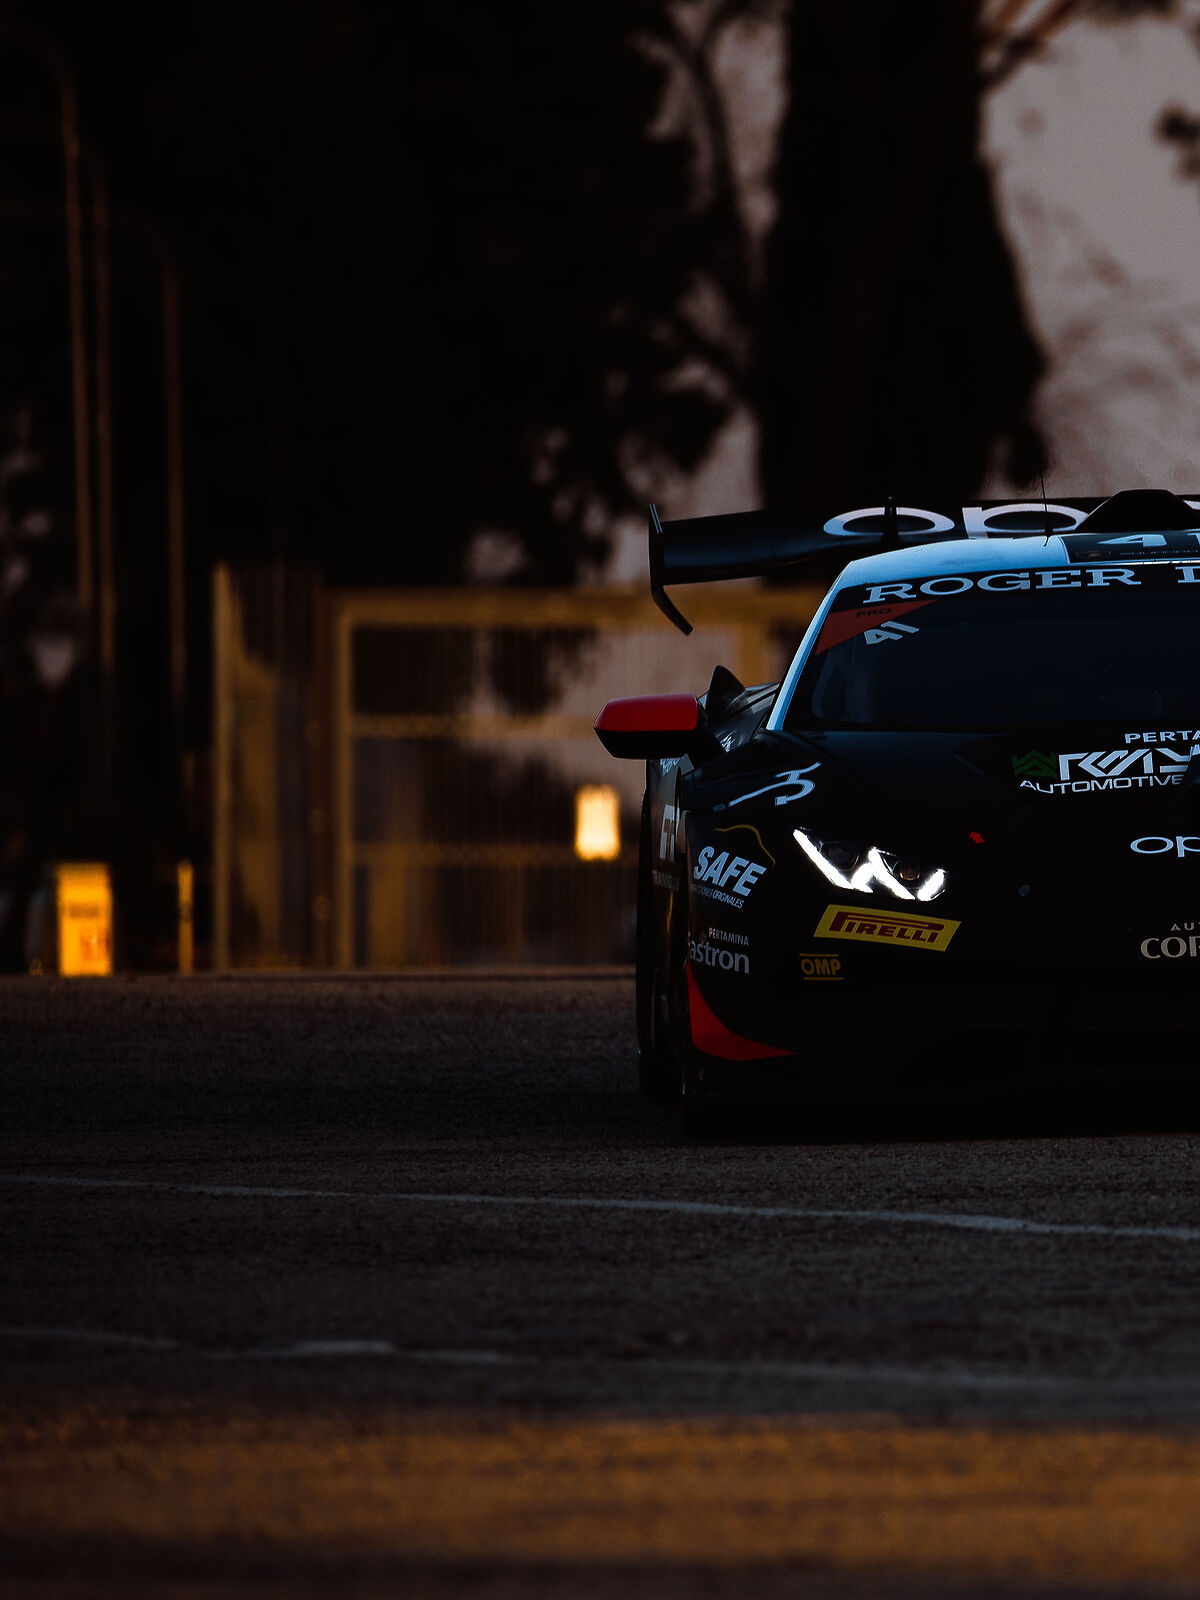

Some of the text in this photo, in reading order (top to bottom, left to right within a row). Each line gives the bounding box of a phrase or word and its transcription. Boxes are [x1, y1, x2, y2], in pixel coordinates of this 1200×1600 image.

[862, 567, 1141, 604] ROGER
[863, 620, 920, 646] 41
[1019, 773, 1185, 795] AUTOMOTIVE
[693, 845, 767, 897] SAFE
[708, 927, 750, 947] PERTAMINA
[828, 911, 945, 943] PIRELLI
[688, 940, 750, 974] astron
[800, 957, 841, 976] OMP
